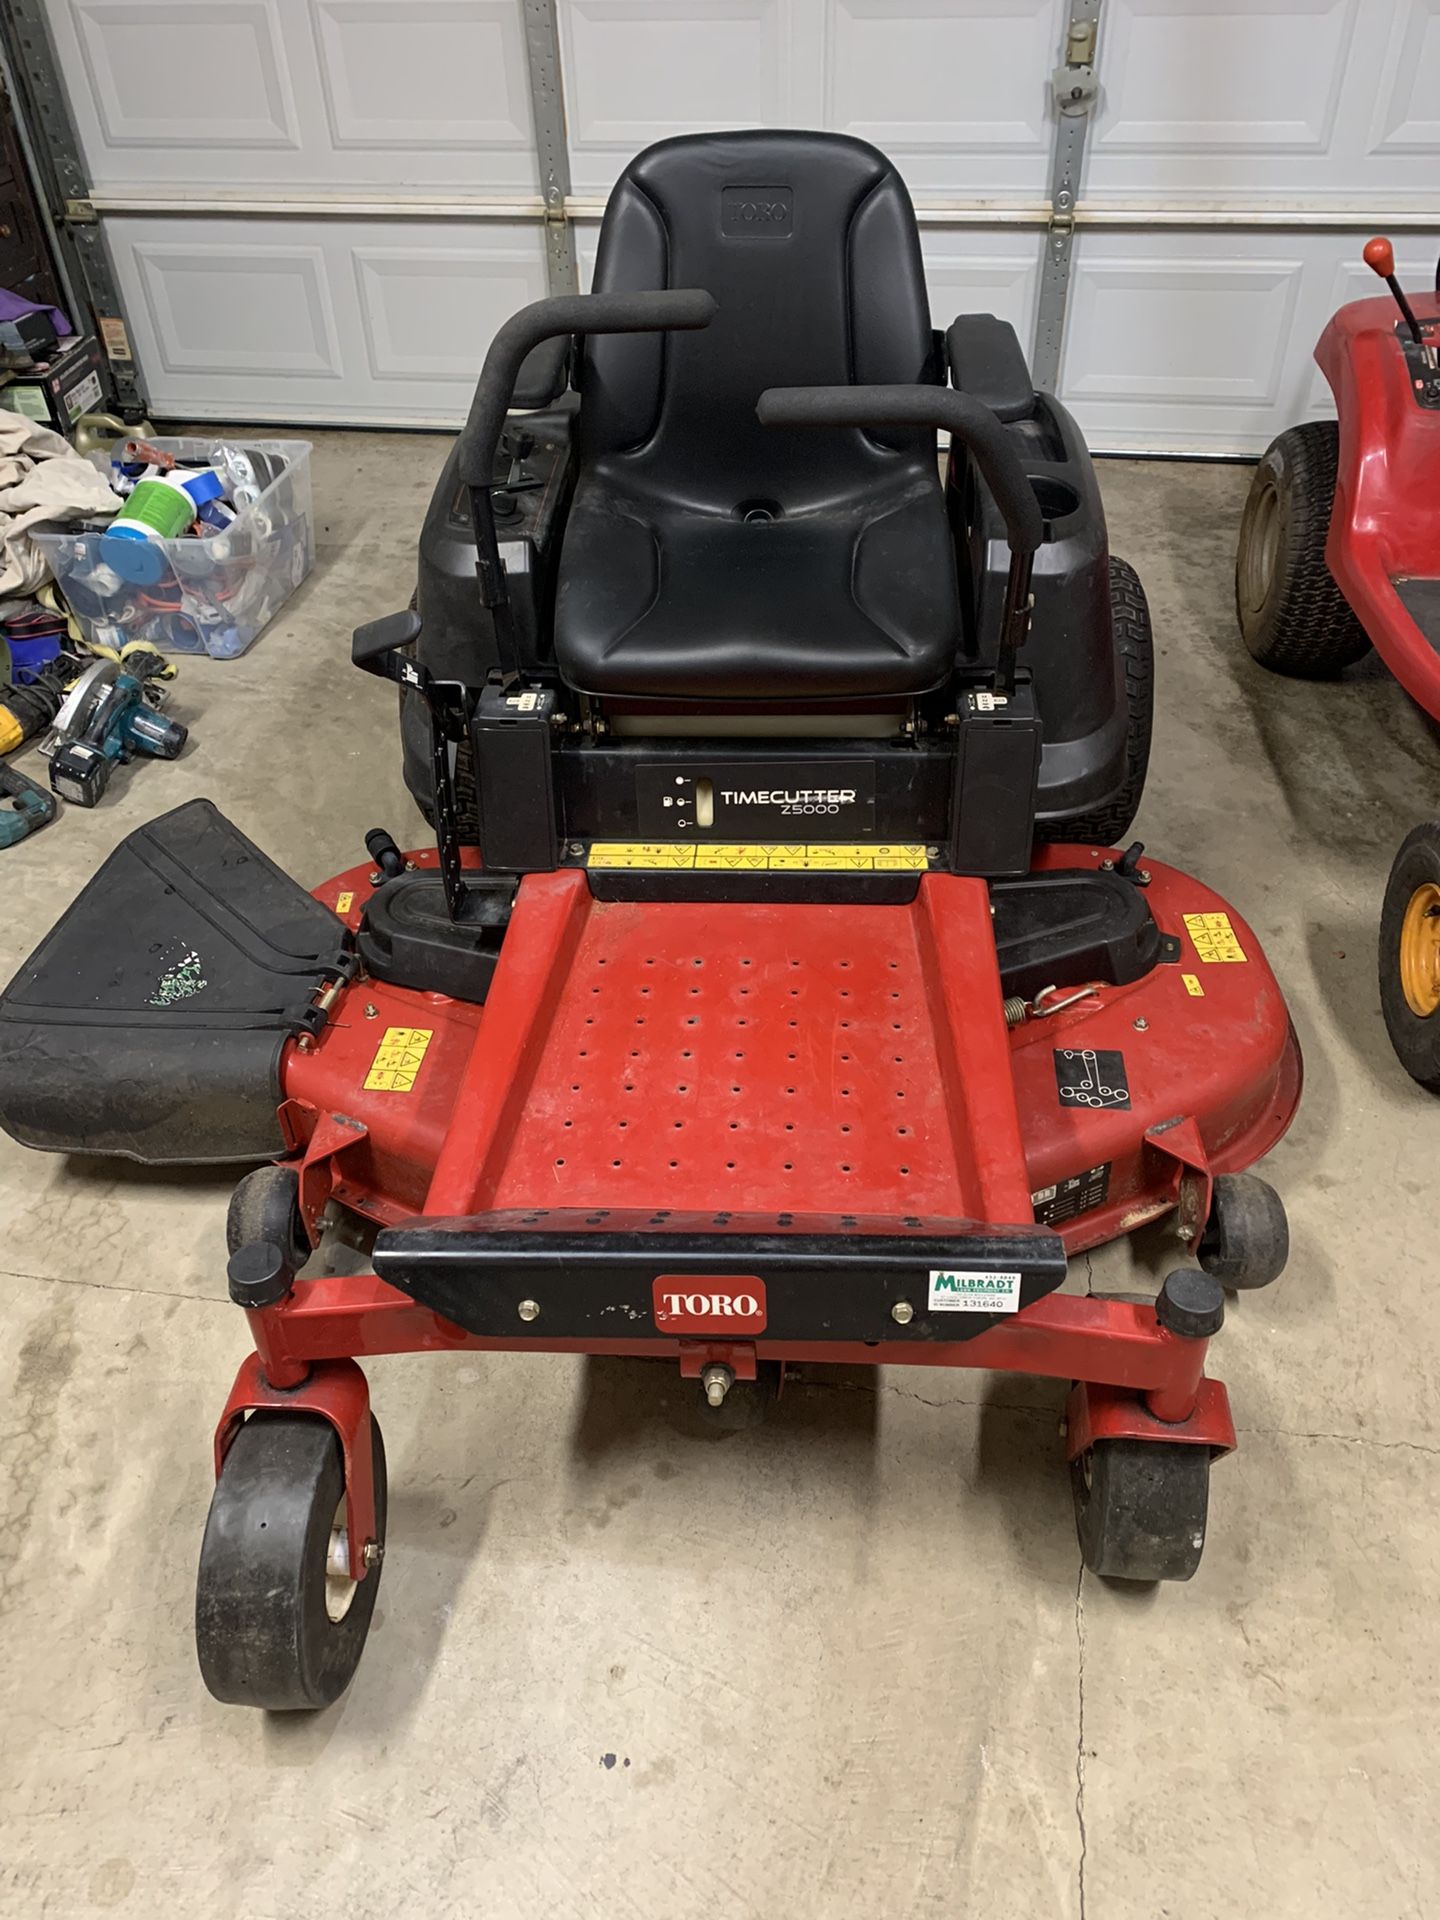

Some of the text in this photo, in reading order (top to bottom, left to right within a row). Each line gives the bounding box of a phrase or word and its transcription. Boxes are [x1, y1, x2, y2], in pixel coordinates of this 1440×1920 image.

[727, 201, 788, 221] TORO
[721, 790, 856, 805] TIMECUTTER
[781, 804, 839, 815] Z5000
[934, 1275, 1014, 1291] MILBRADT
[663, 1294, 759, 1316] TORO
[963, 1300, 1004, 1308] 131640
